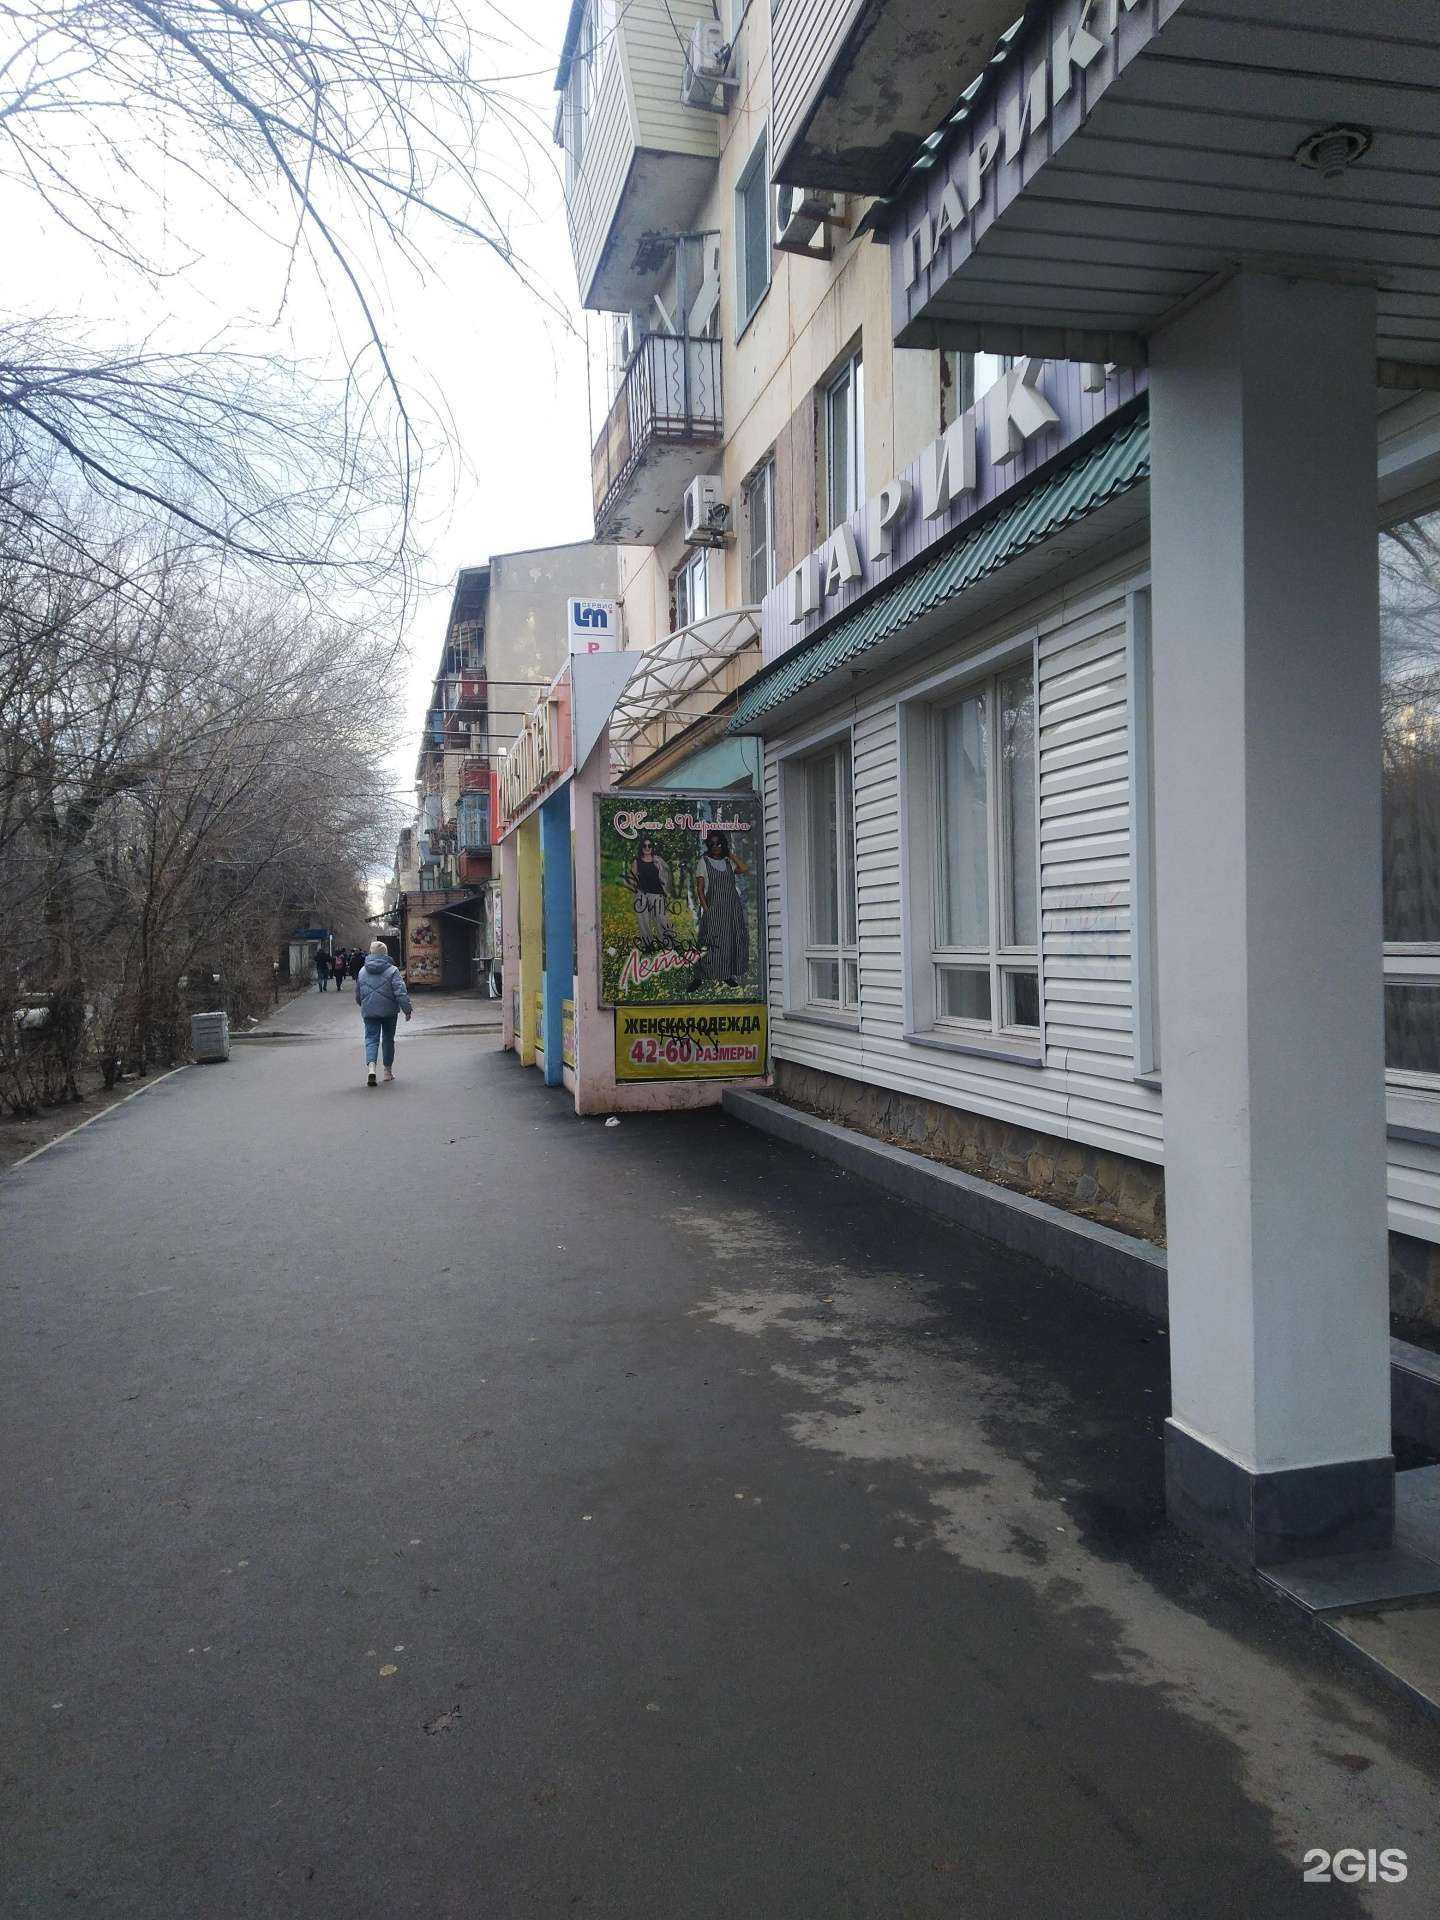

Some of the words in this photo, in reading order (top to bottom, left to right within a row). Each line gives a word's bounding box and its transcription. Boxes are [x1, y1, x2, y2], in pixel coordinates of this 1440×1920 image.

[624, 1017, 696, 1035] ЖЕНСКАЯ
[696, 1015, 761, 1035] ОДЕЖДА
[631, 1038, 693, 1064] 42-60
[695, 1045, 757, 1062] РАЗМЕРЫ
